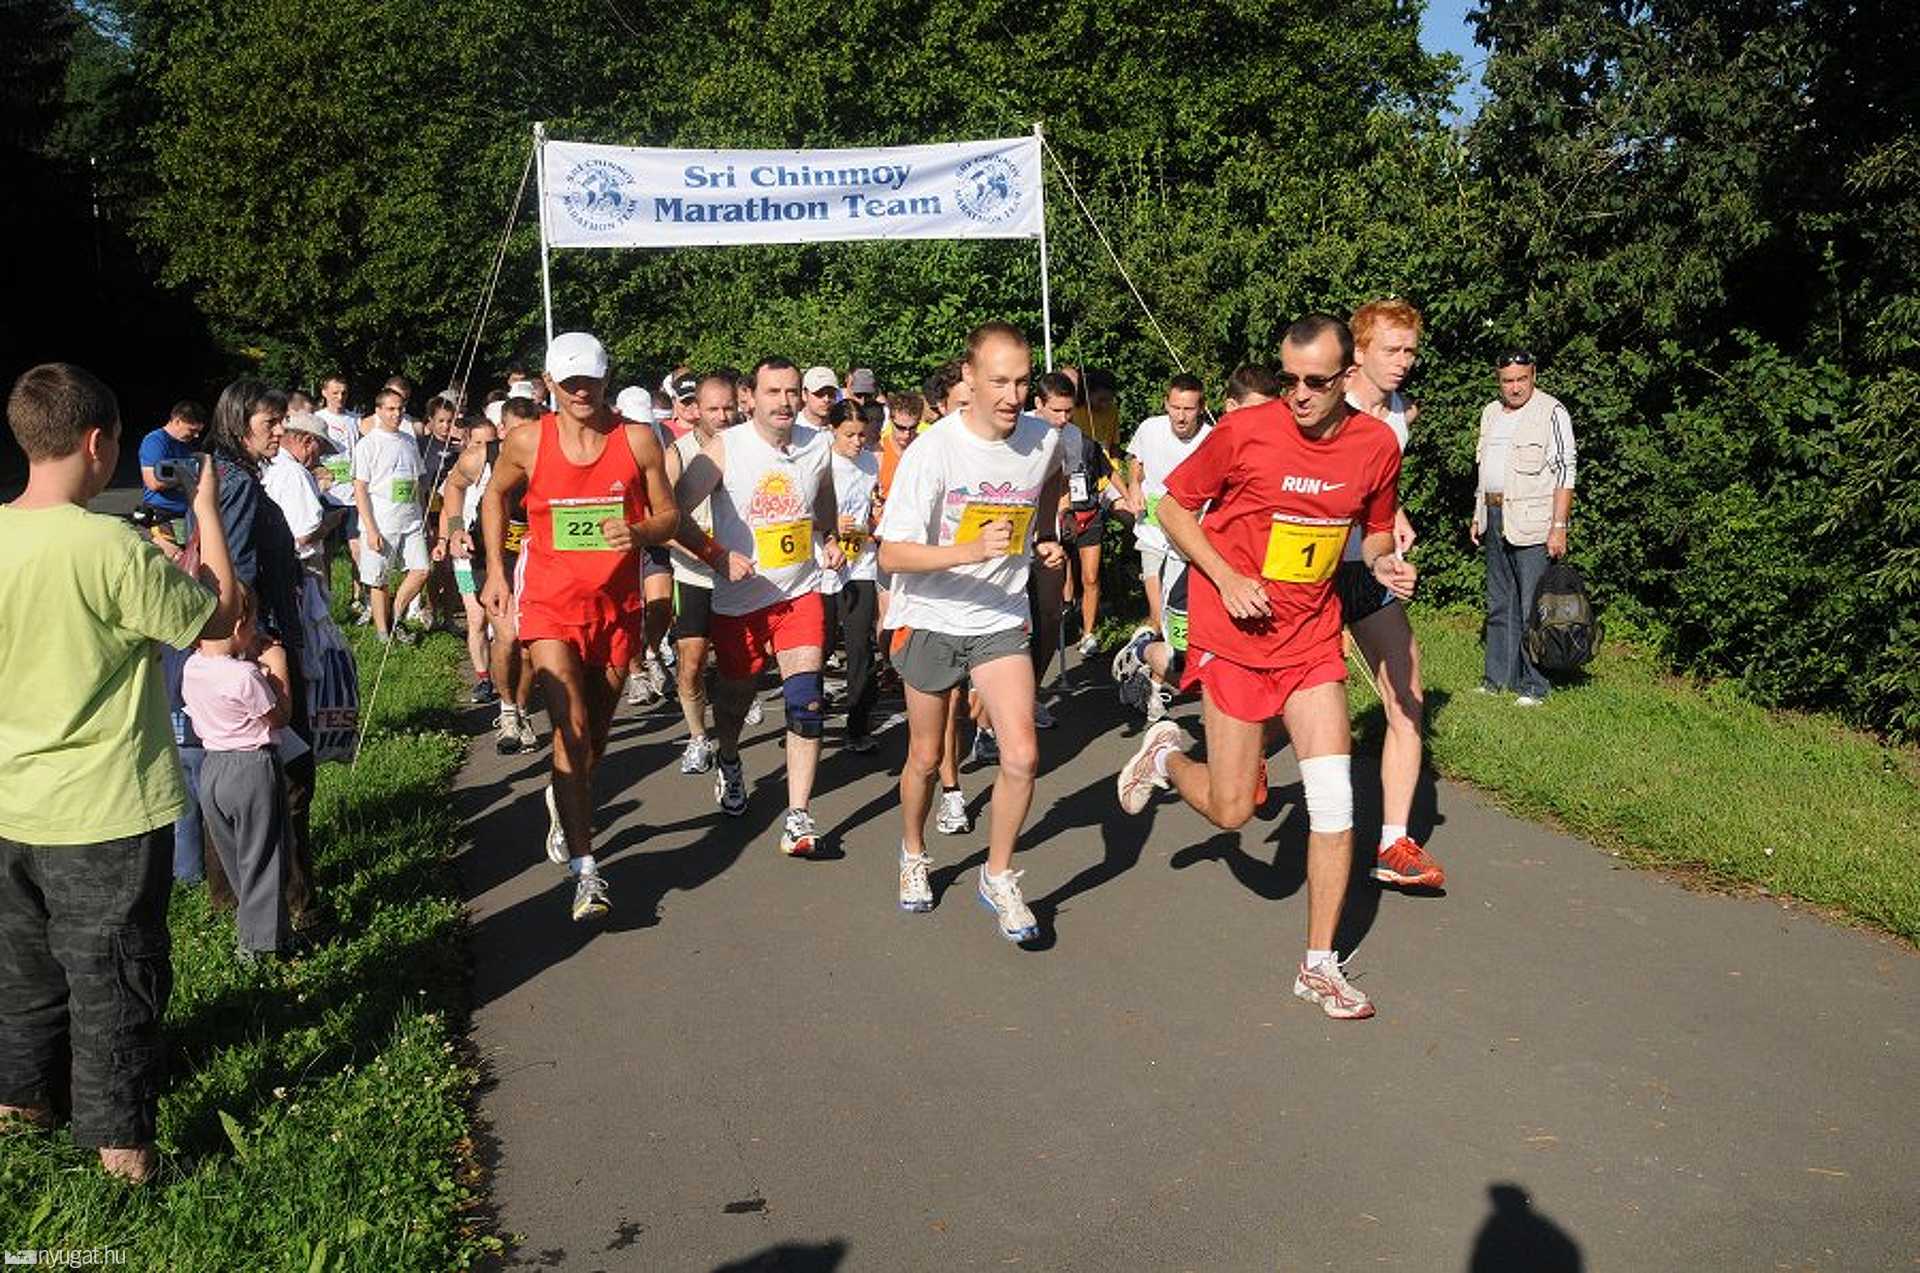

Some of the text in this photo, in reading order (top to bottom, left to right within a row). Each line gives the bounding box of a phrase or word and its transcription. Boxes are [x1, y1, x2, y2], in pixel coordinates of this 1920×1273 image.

[684, 163, 912, 191] Sri Chinmoy
[654, 193, 942, 223] Marathon Team
[1281, 475, 1322, 495] RUN
[780, 535, 795, 554] 6
[1300, 542, 1317, 568] 1
